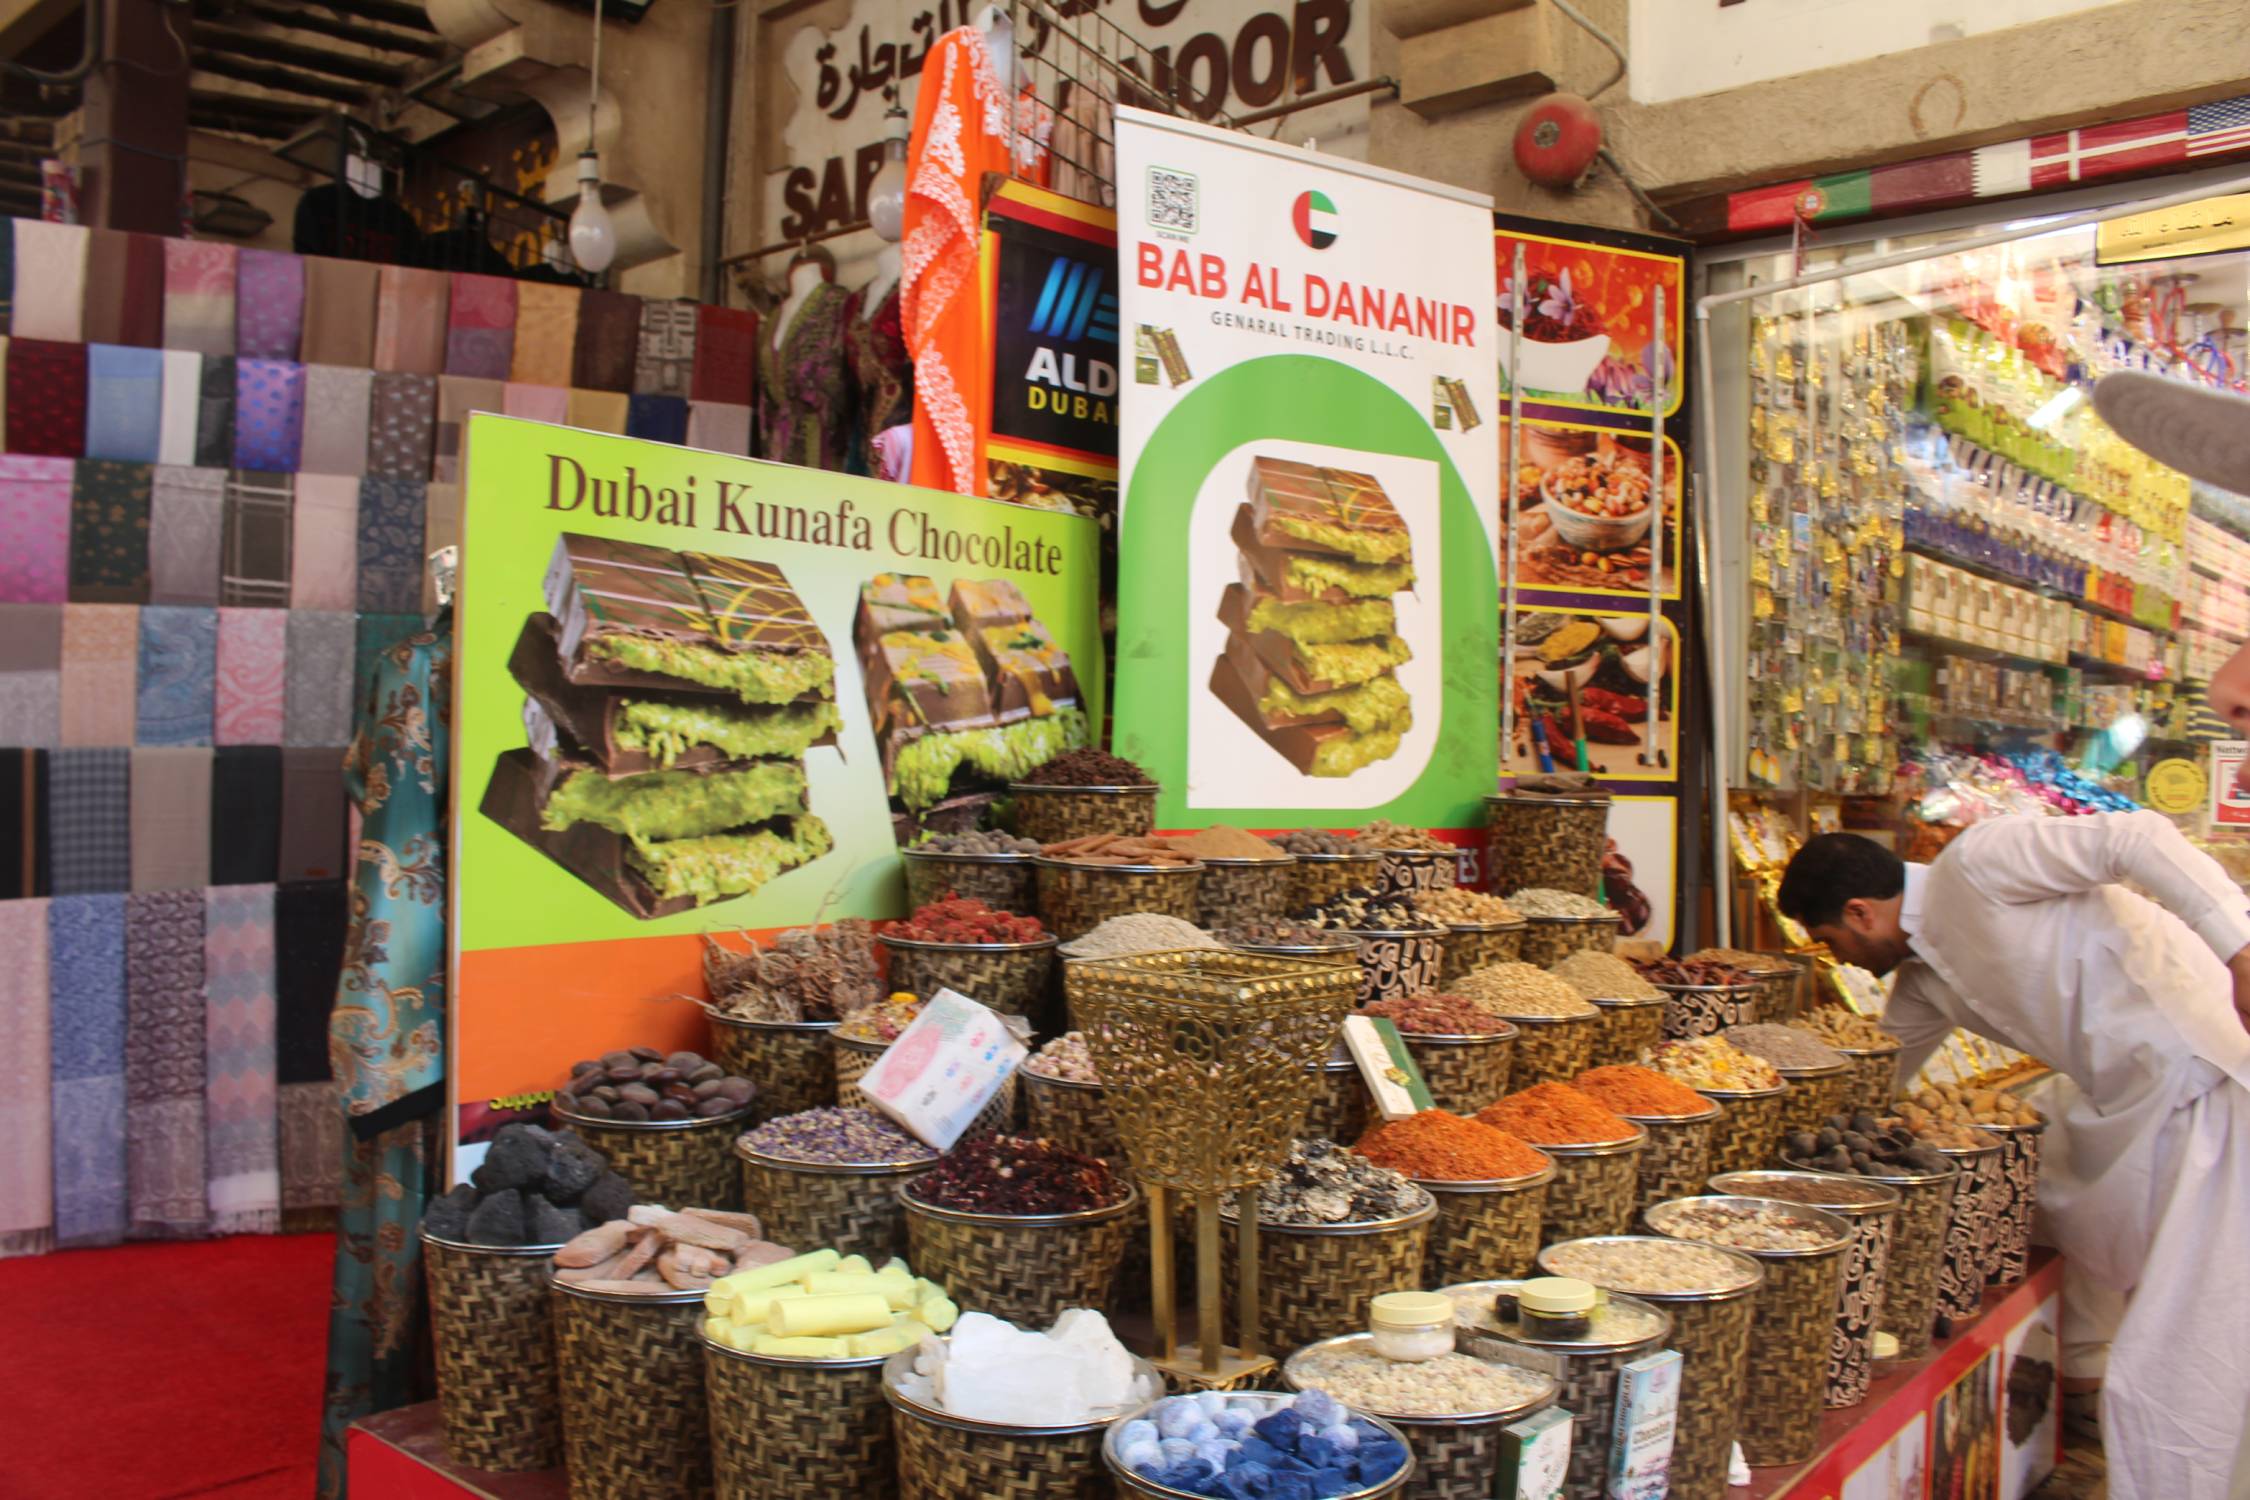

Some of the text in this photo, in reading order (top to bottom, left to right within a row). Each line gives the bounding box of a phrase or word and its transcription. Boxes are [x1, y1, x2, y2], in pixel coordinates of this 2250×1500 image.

[1137, 241, 1476, 347] BAB AL DANANIR
[1210, 311, 1415, 360] GENARAL TRADING L.L.C.
[544, 453, 1063, 576] Dubai Kunafa Chocolate
